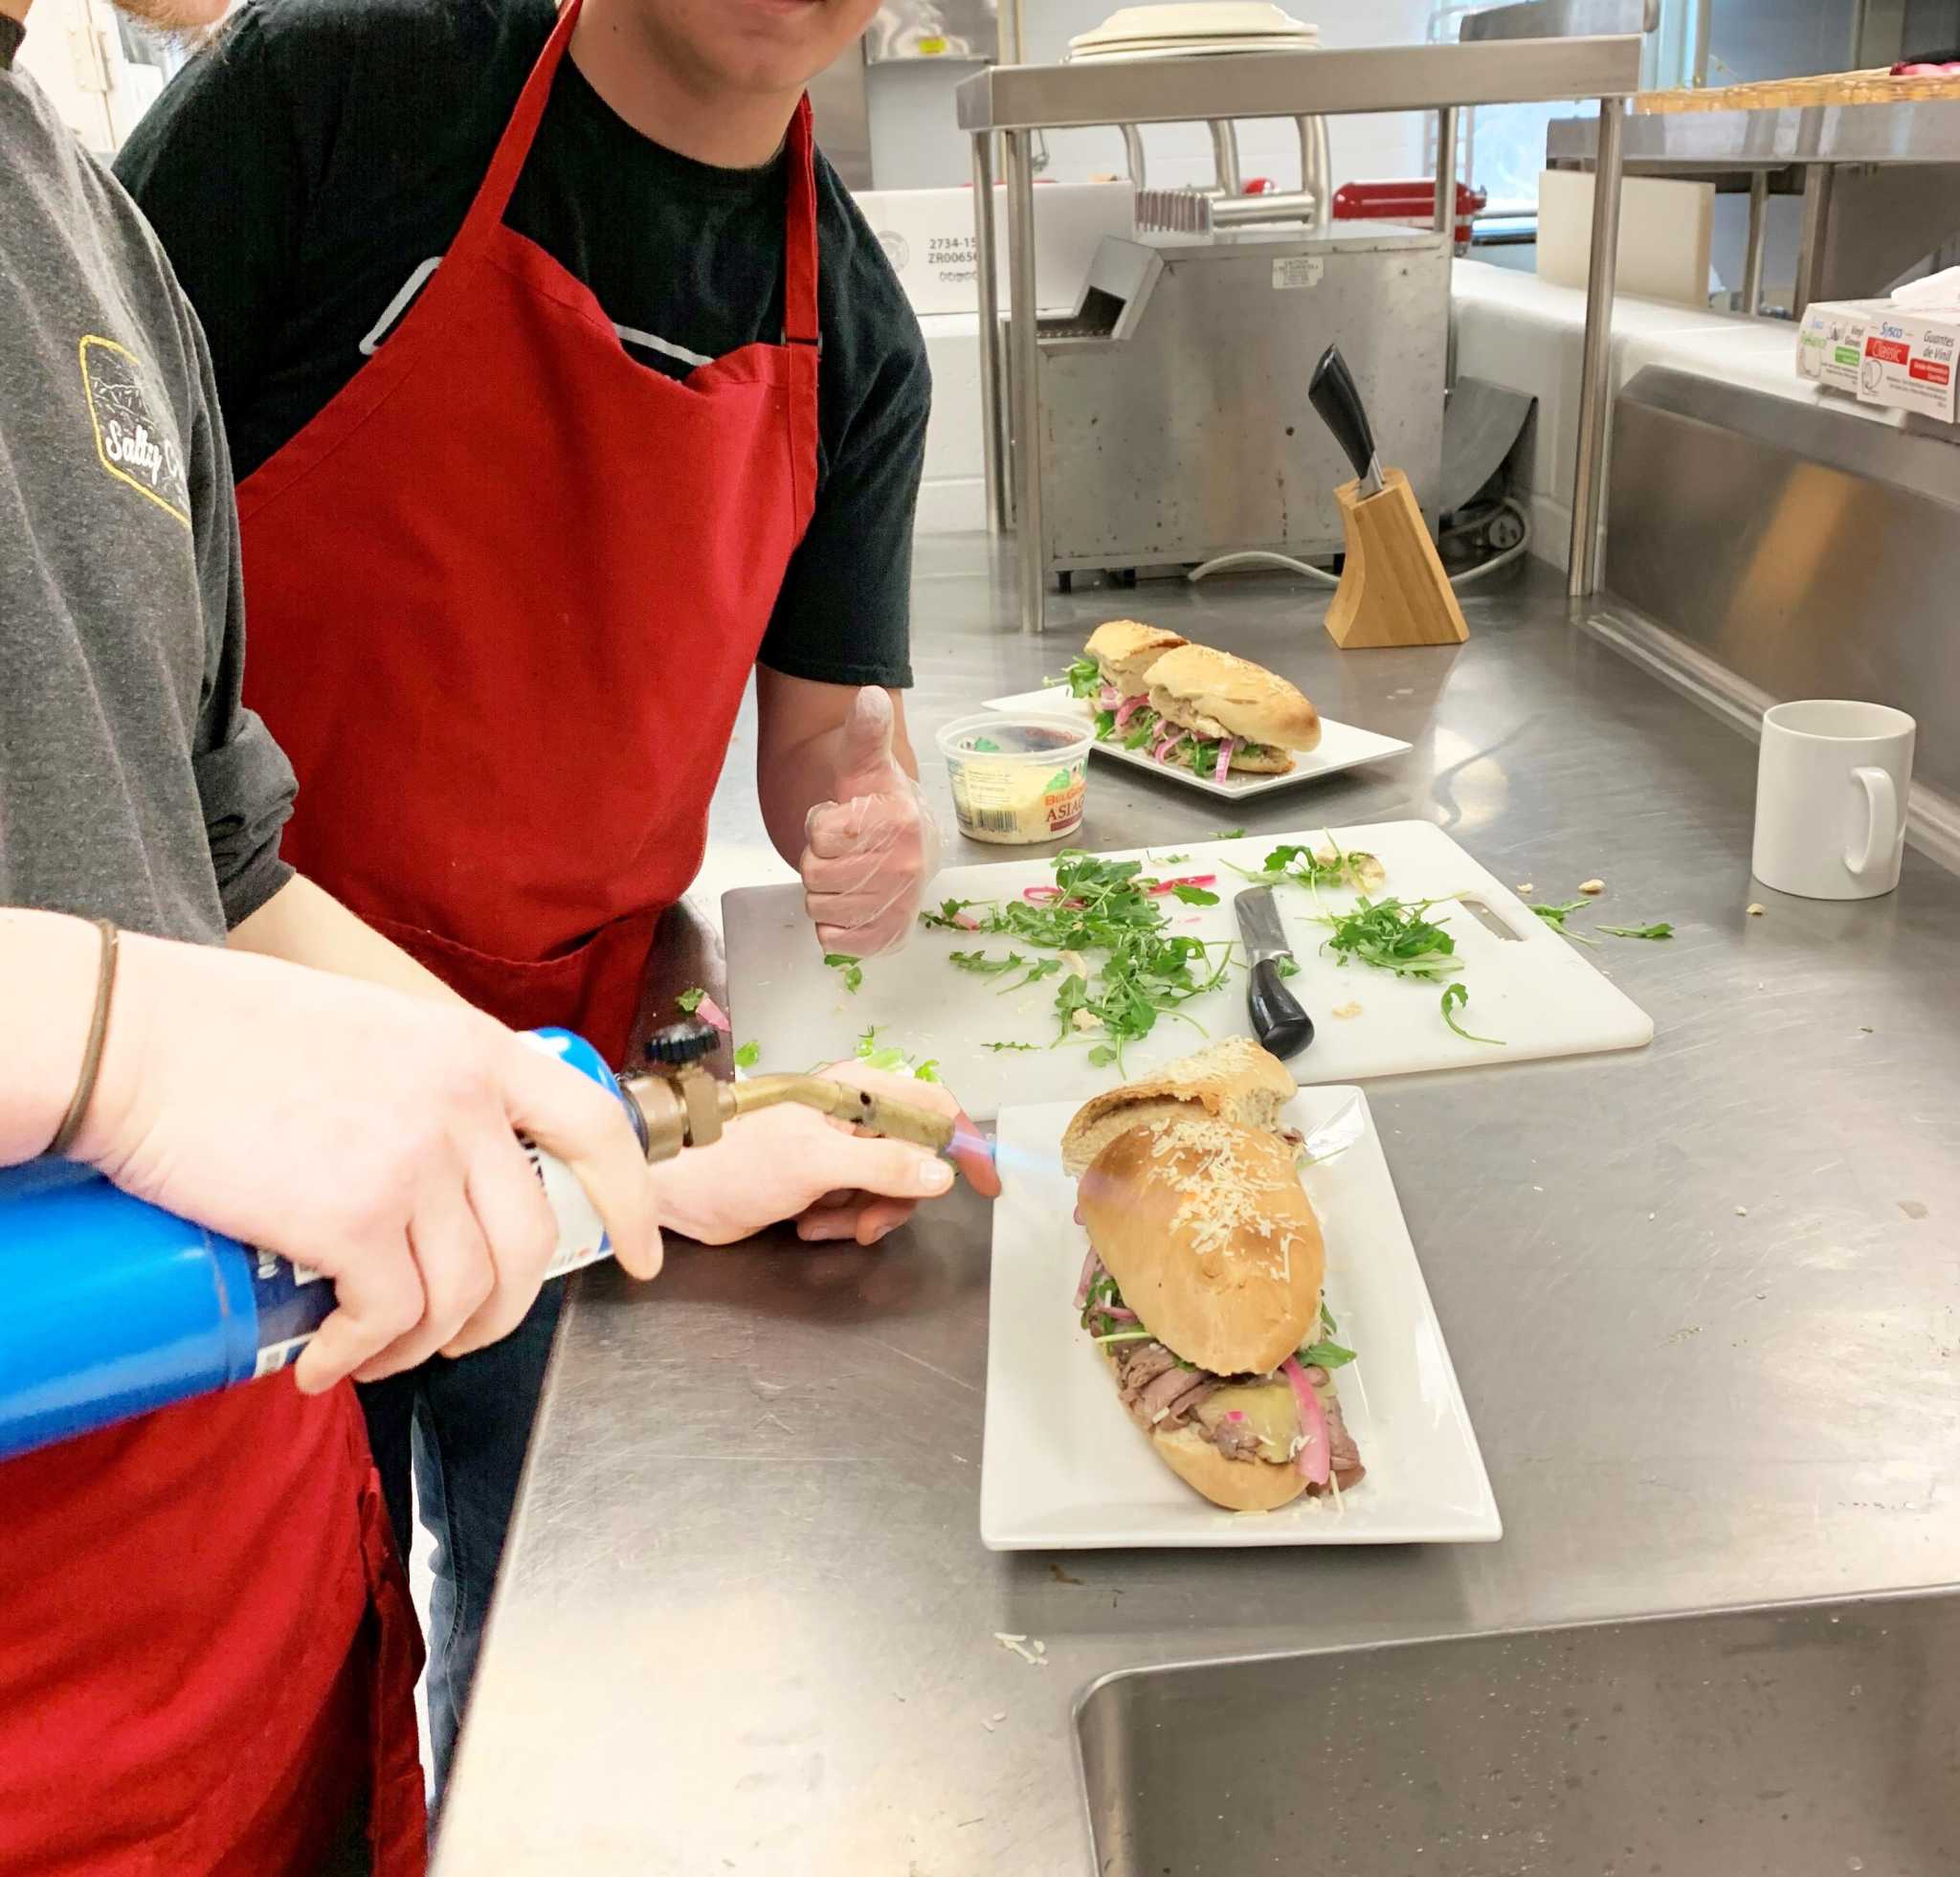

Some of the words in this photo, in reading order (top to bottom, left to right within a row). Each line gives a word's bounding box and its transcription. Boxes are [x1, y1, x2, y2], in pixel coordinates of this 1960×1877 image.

[1881, 322, 1904, 339] Sysco
[1923, 330, 1955, 347] Guantes
[1872, 340, 1903, 363] Classic
[1923, 346, 1933, 358] de
[1934, 347, 1952, 361] Vinil
[105, 419, 162, 485] Salty
